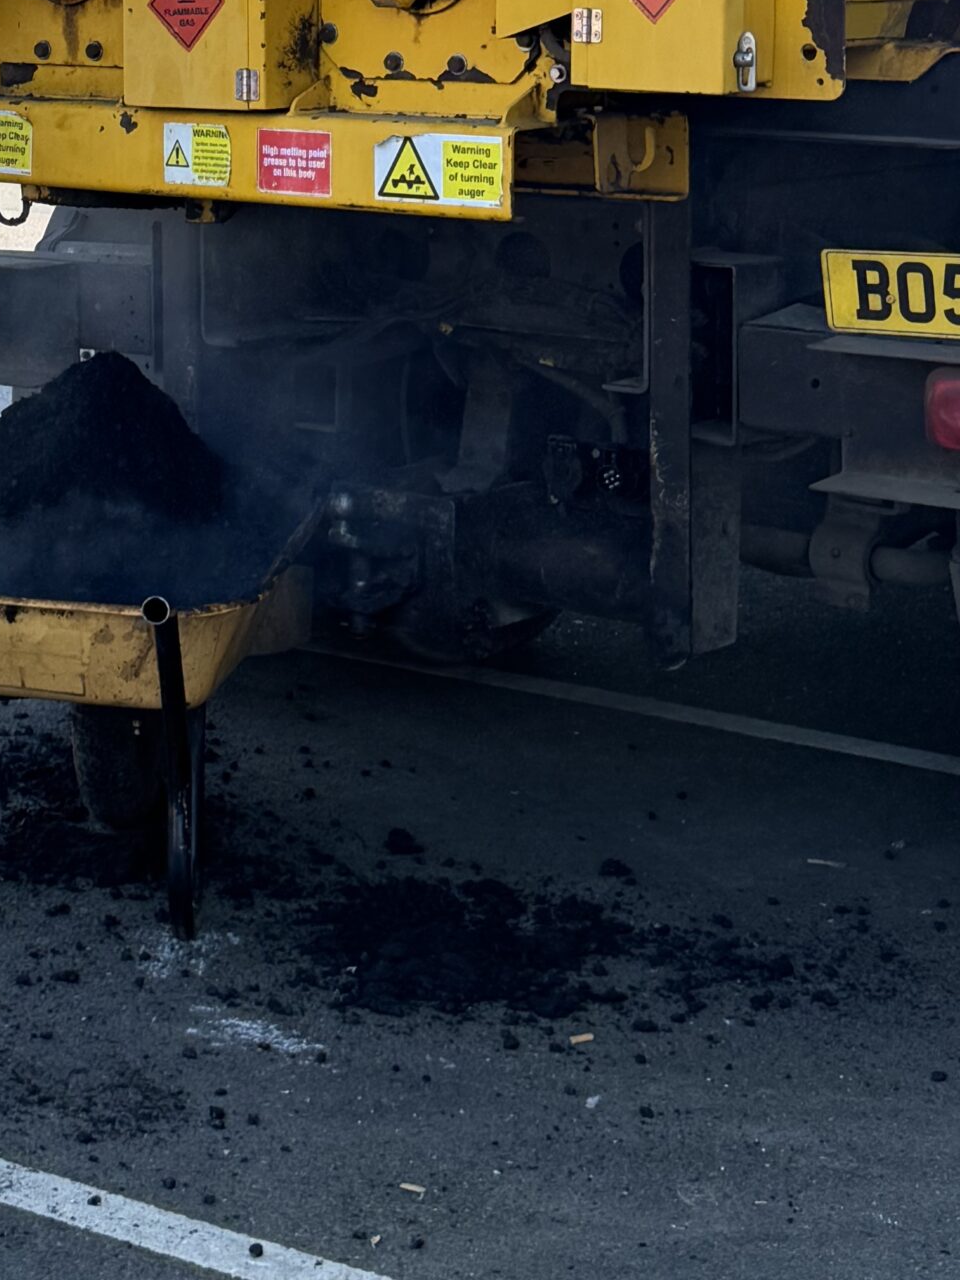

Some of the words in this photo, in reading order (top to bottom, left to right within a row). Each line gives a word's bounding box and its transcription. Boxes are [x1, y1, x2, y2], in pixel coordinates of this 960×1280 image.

[164, 7, 209, 16] FLAMMABLE
[179, 18, 196, 27] GAS
[8, 131, 30, 146] Clear
[0, 144, 26, 156] turning
[262, 144, 279, 157] High
[280, 146, 307, 159] melting
[308, 148, 327, 159] point
[451, 144, 491, 158] Warning
[263, 157, 287, 167] grease
[288, 157, 296, 167] to
[298, 158, 307, 168] be
[308, 159, 326, 169] used
[446, 158, 470, 170] Keep
[472, 159, 498, 170] Clear
[273, 168, 282, 176] on
[283, 167, 296, 177] this
[298, 168, 316, 181] body
[448, 172, 458, 181] of
[460, 173, 494, 186] turning
[458, 188, 486, 199] auger
